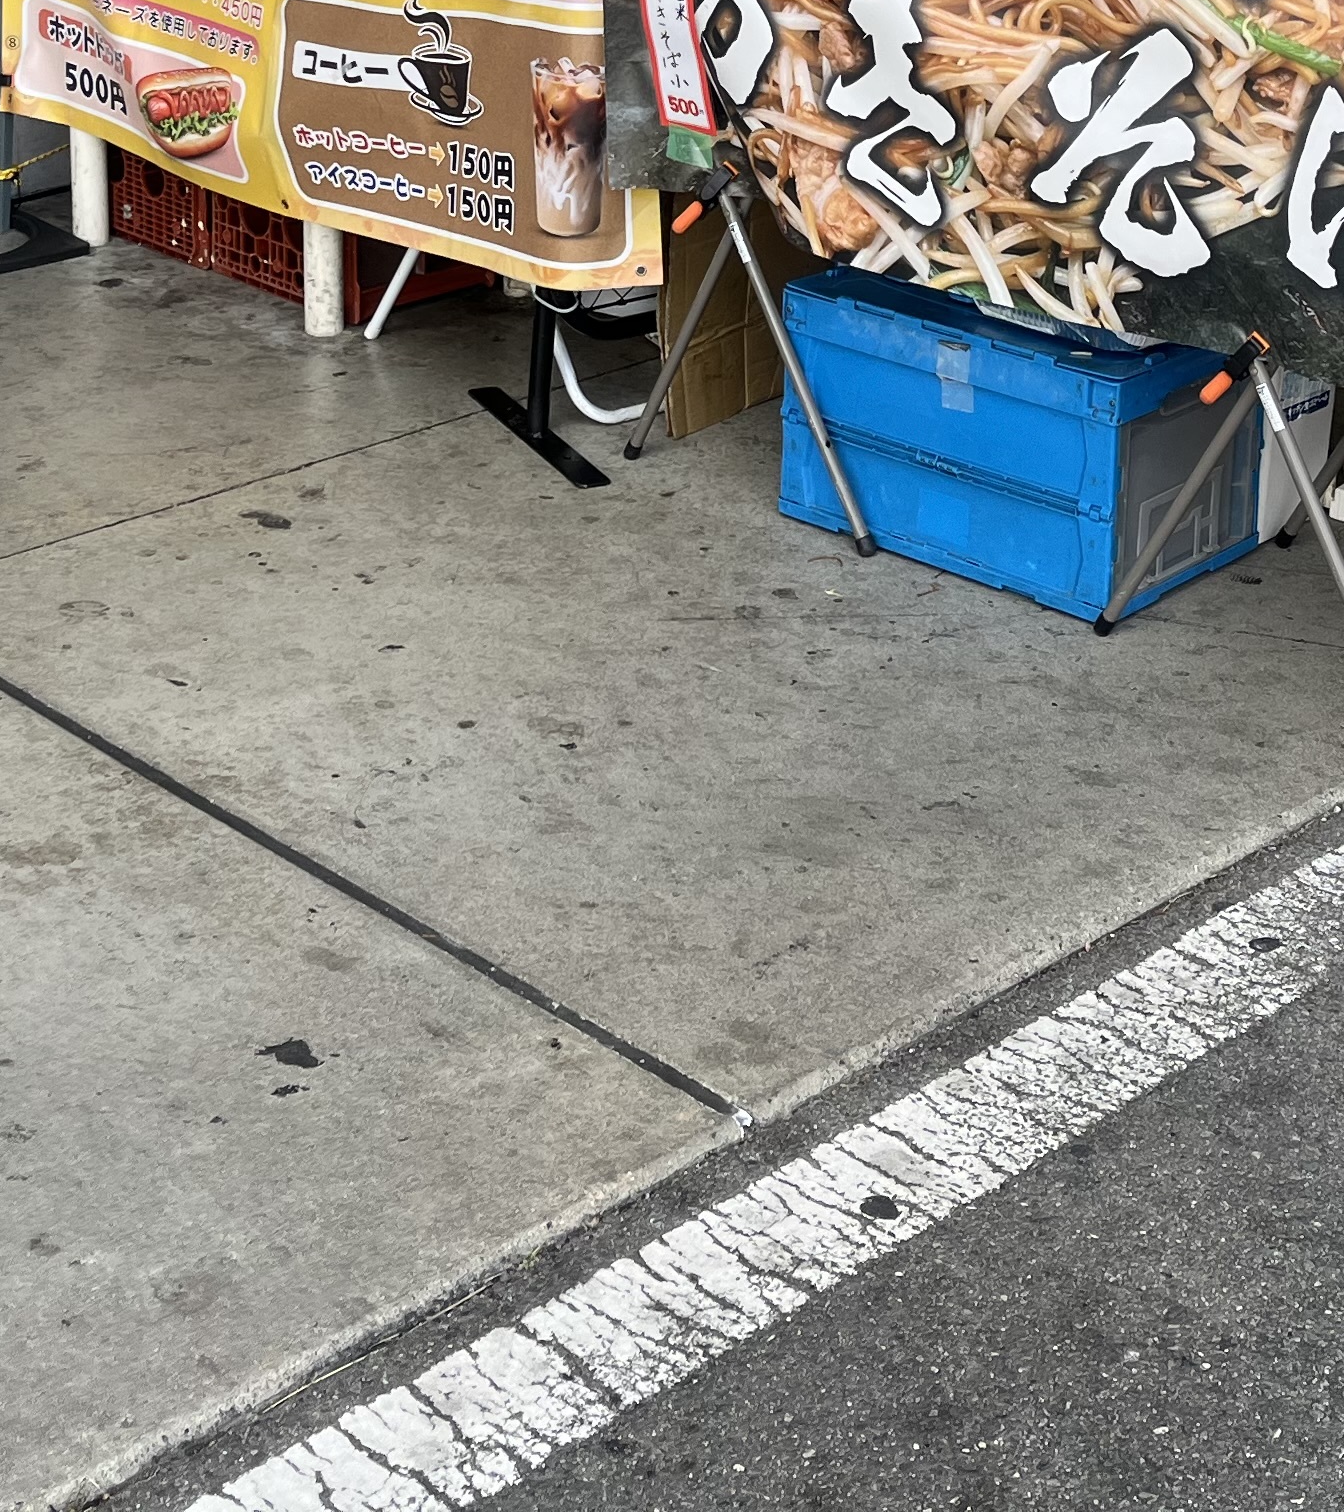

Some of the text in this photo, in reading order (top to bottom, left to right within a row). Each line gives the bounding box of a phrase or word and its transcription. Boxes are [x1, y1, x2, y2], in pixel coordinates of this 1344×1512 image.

[65, 61, 128, 116] 500円
[302, 49, 389, 83] コーヒー
[294, 125, 515, 191] ホットコーヒー 150円
[306, 163, 515, 234] アイスコーヒー 150円
